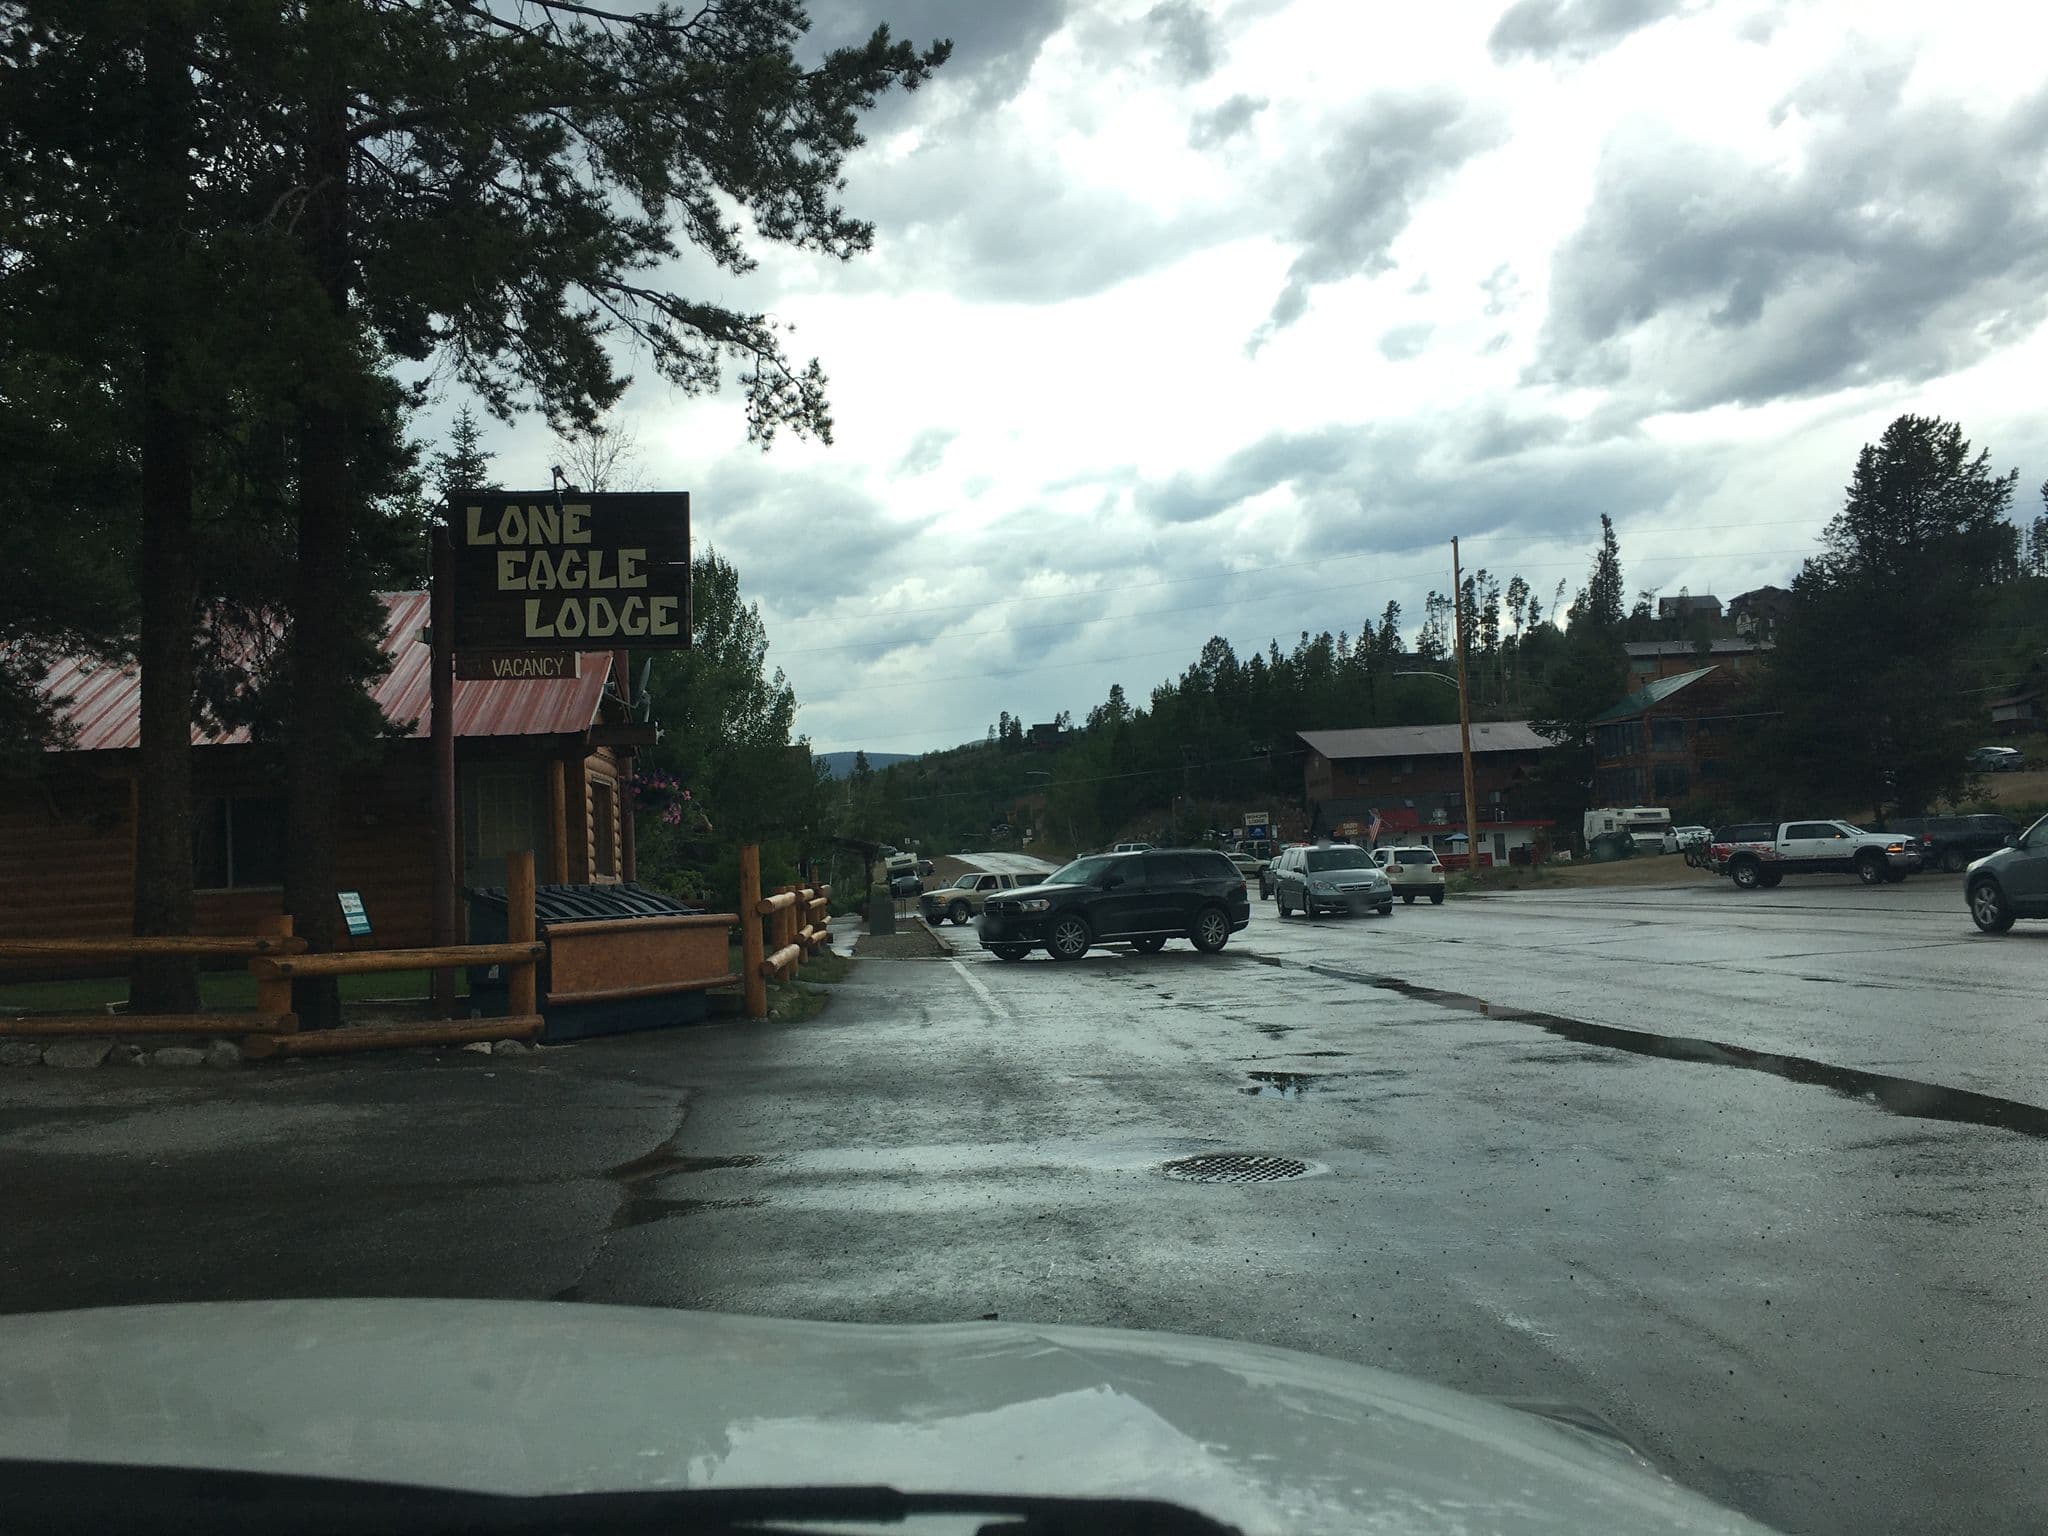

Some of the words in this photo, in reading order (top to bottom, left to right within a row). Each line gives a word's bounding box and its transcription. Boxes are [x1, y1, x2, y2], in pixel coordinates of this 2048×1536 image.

[466, 504, 592, 546] LONE
[497, 548, 648, 591] EAGLE
[524, 595, 679, 638] LODGE
[491, 656, 564, 678] VACANCY
